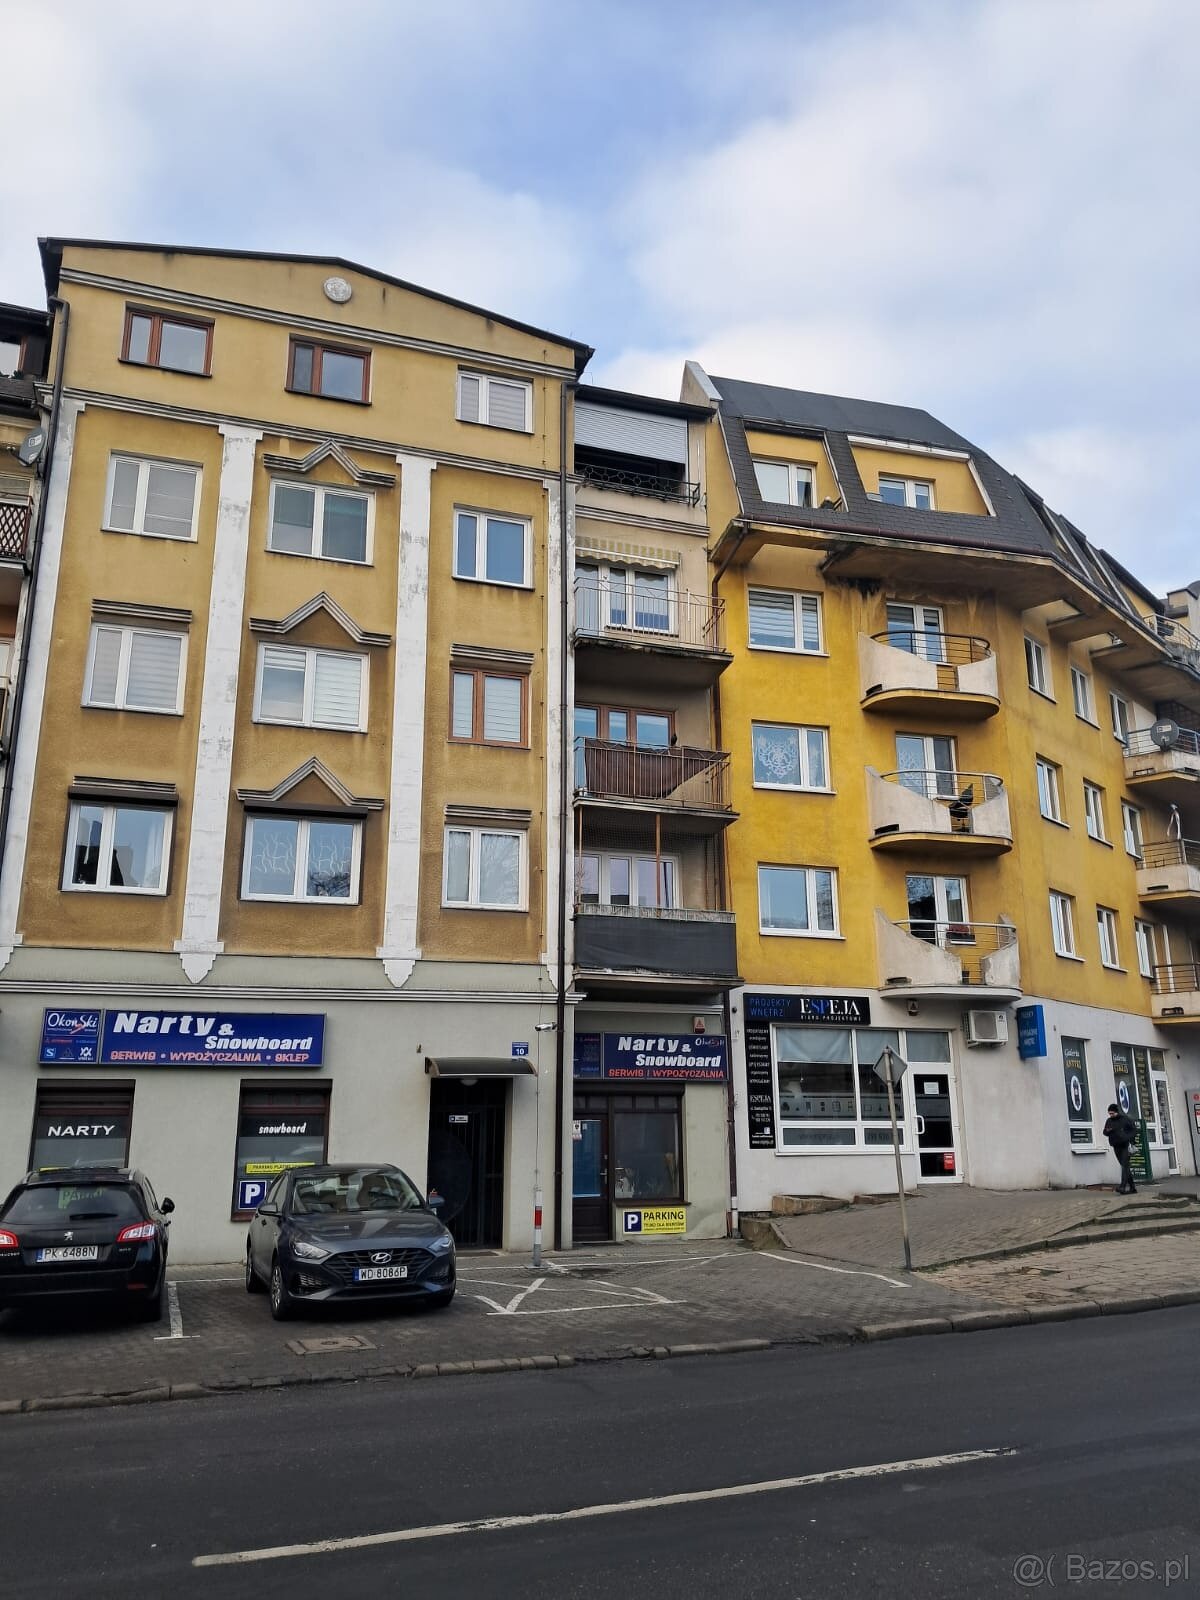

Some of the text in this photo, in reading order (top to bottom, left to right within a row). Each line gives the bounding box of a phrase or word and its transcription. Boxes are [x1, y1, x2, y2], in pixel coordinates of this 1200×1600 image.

[800, 998, 860, 1015] ESPEJA
[113, 1012, 235, 1036] Narty &
[205, 1035, 313, 1050] Snowboard
[618, 1036, 679, 1053] Narty
[681, 1043, 692, 1053] &
[111, 1051, 309, 1062] SERWIS WYPOŻYCZALNIA SKLEP
[635, 1054, 721, 1067] Snowboard
[608, 1069, 644, 1078] SERWIS
[47, 1125, 115, 1137] NARTY
[258, 1122, 307, 1134] snowboard
[245, 1184, 261, 1204] P
[627, 1214, 639, 1229] P
[643, 1211, 684, 1220] PARKING
[44, 1246, 96, 1258] PK 6488N
[361, 1266, 406, 1279] WD 8086P
